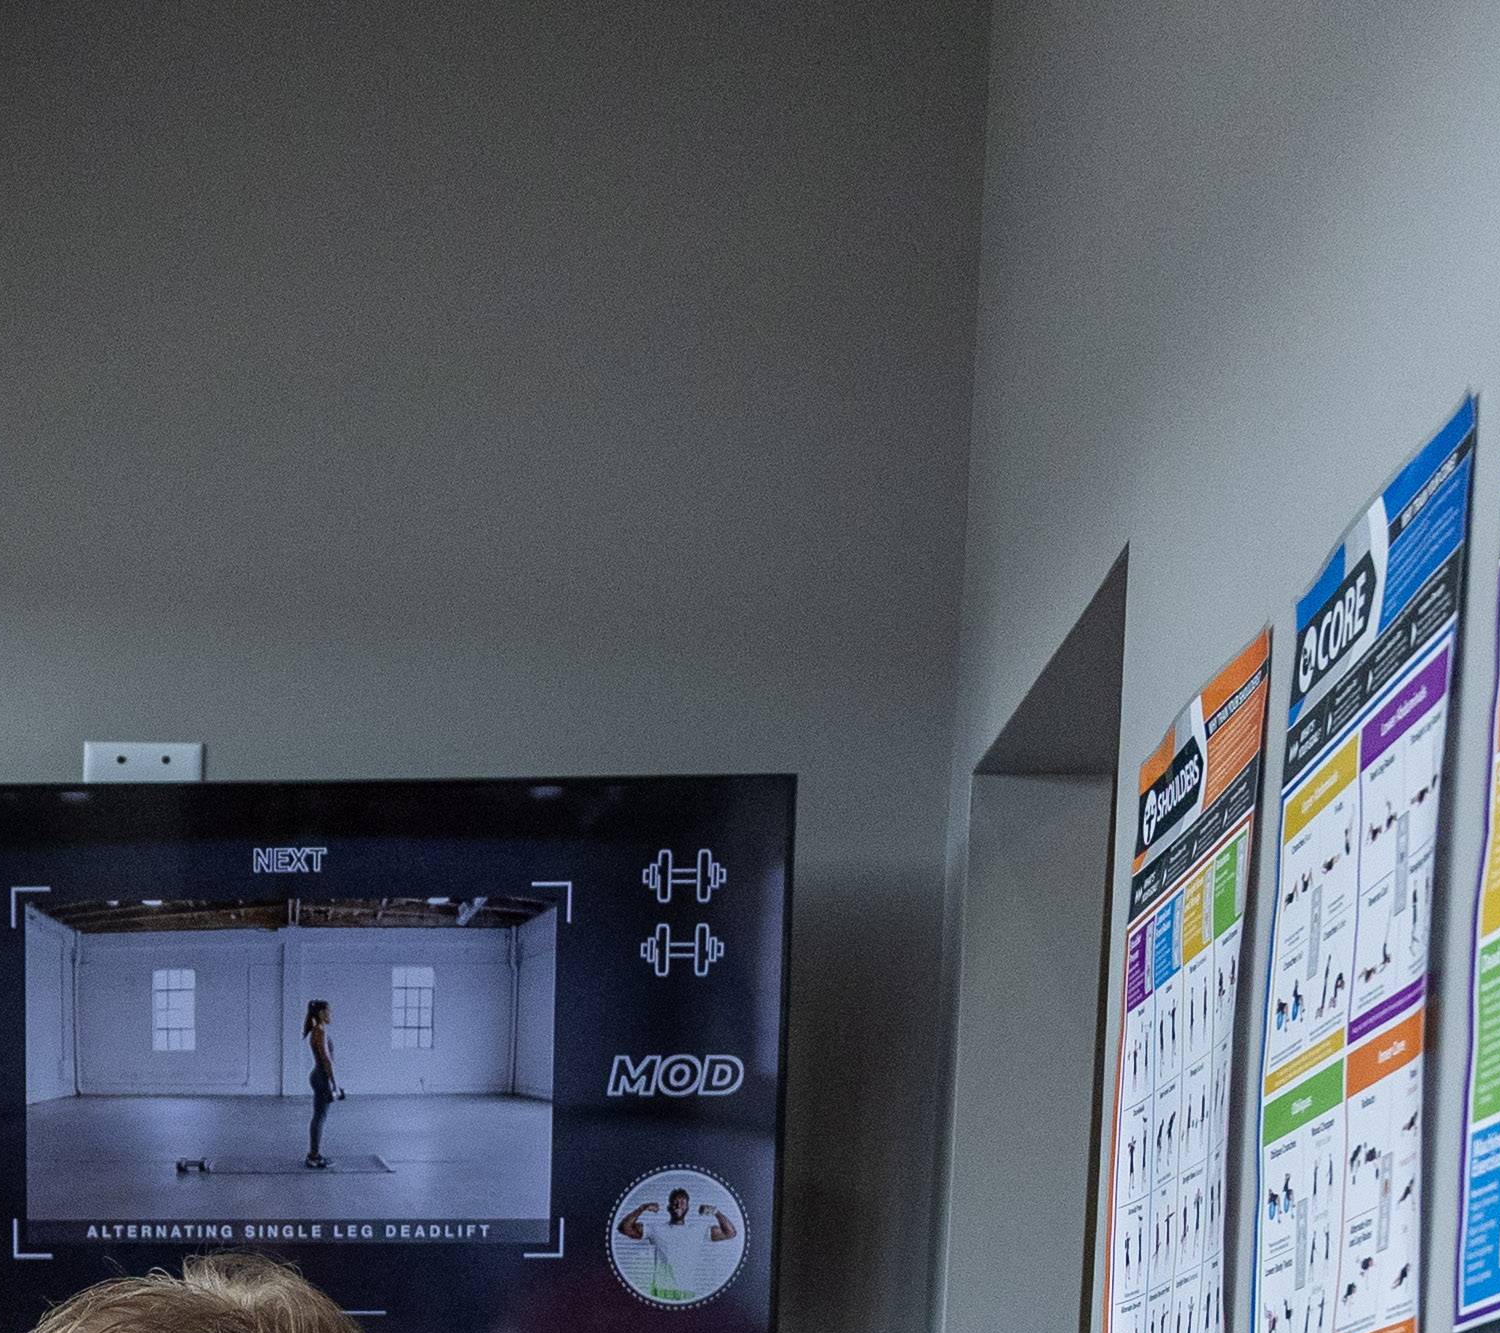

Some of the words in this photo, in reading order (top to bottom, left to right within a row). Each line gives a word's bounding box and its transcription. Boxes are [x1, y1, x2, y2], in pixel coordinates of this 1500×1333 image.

[1317, 571, 1366, 670] CORE
[1157, 753, 1200, 822] SHOULDERS
[253, 847, 327, 873] NEXT
[607, 1054, 745, 1097] MOD
[87, 1224, 233, 1239] ALTERNATING
[245, 1224, 323, 1239] SINGLE
[333, 1224, 374, 1238] LEG
[385, 1224, 491, 1238] DEADLIFT
